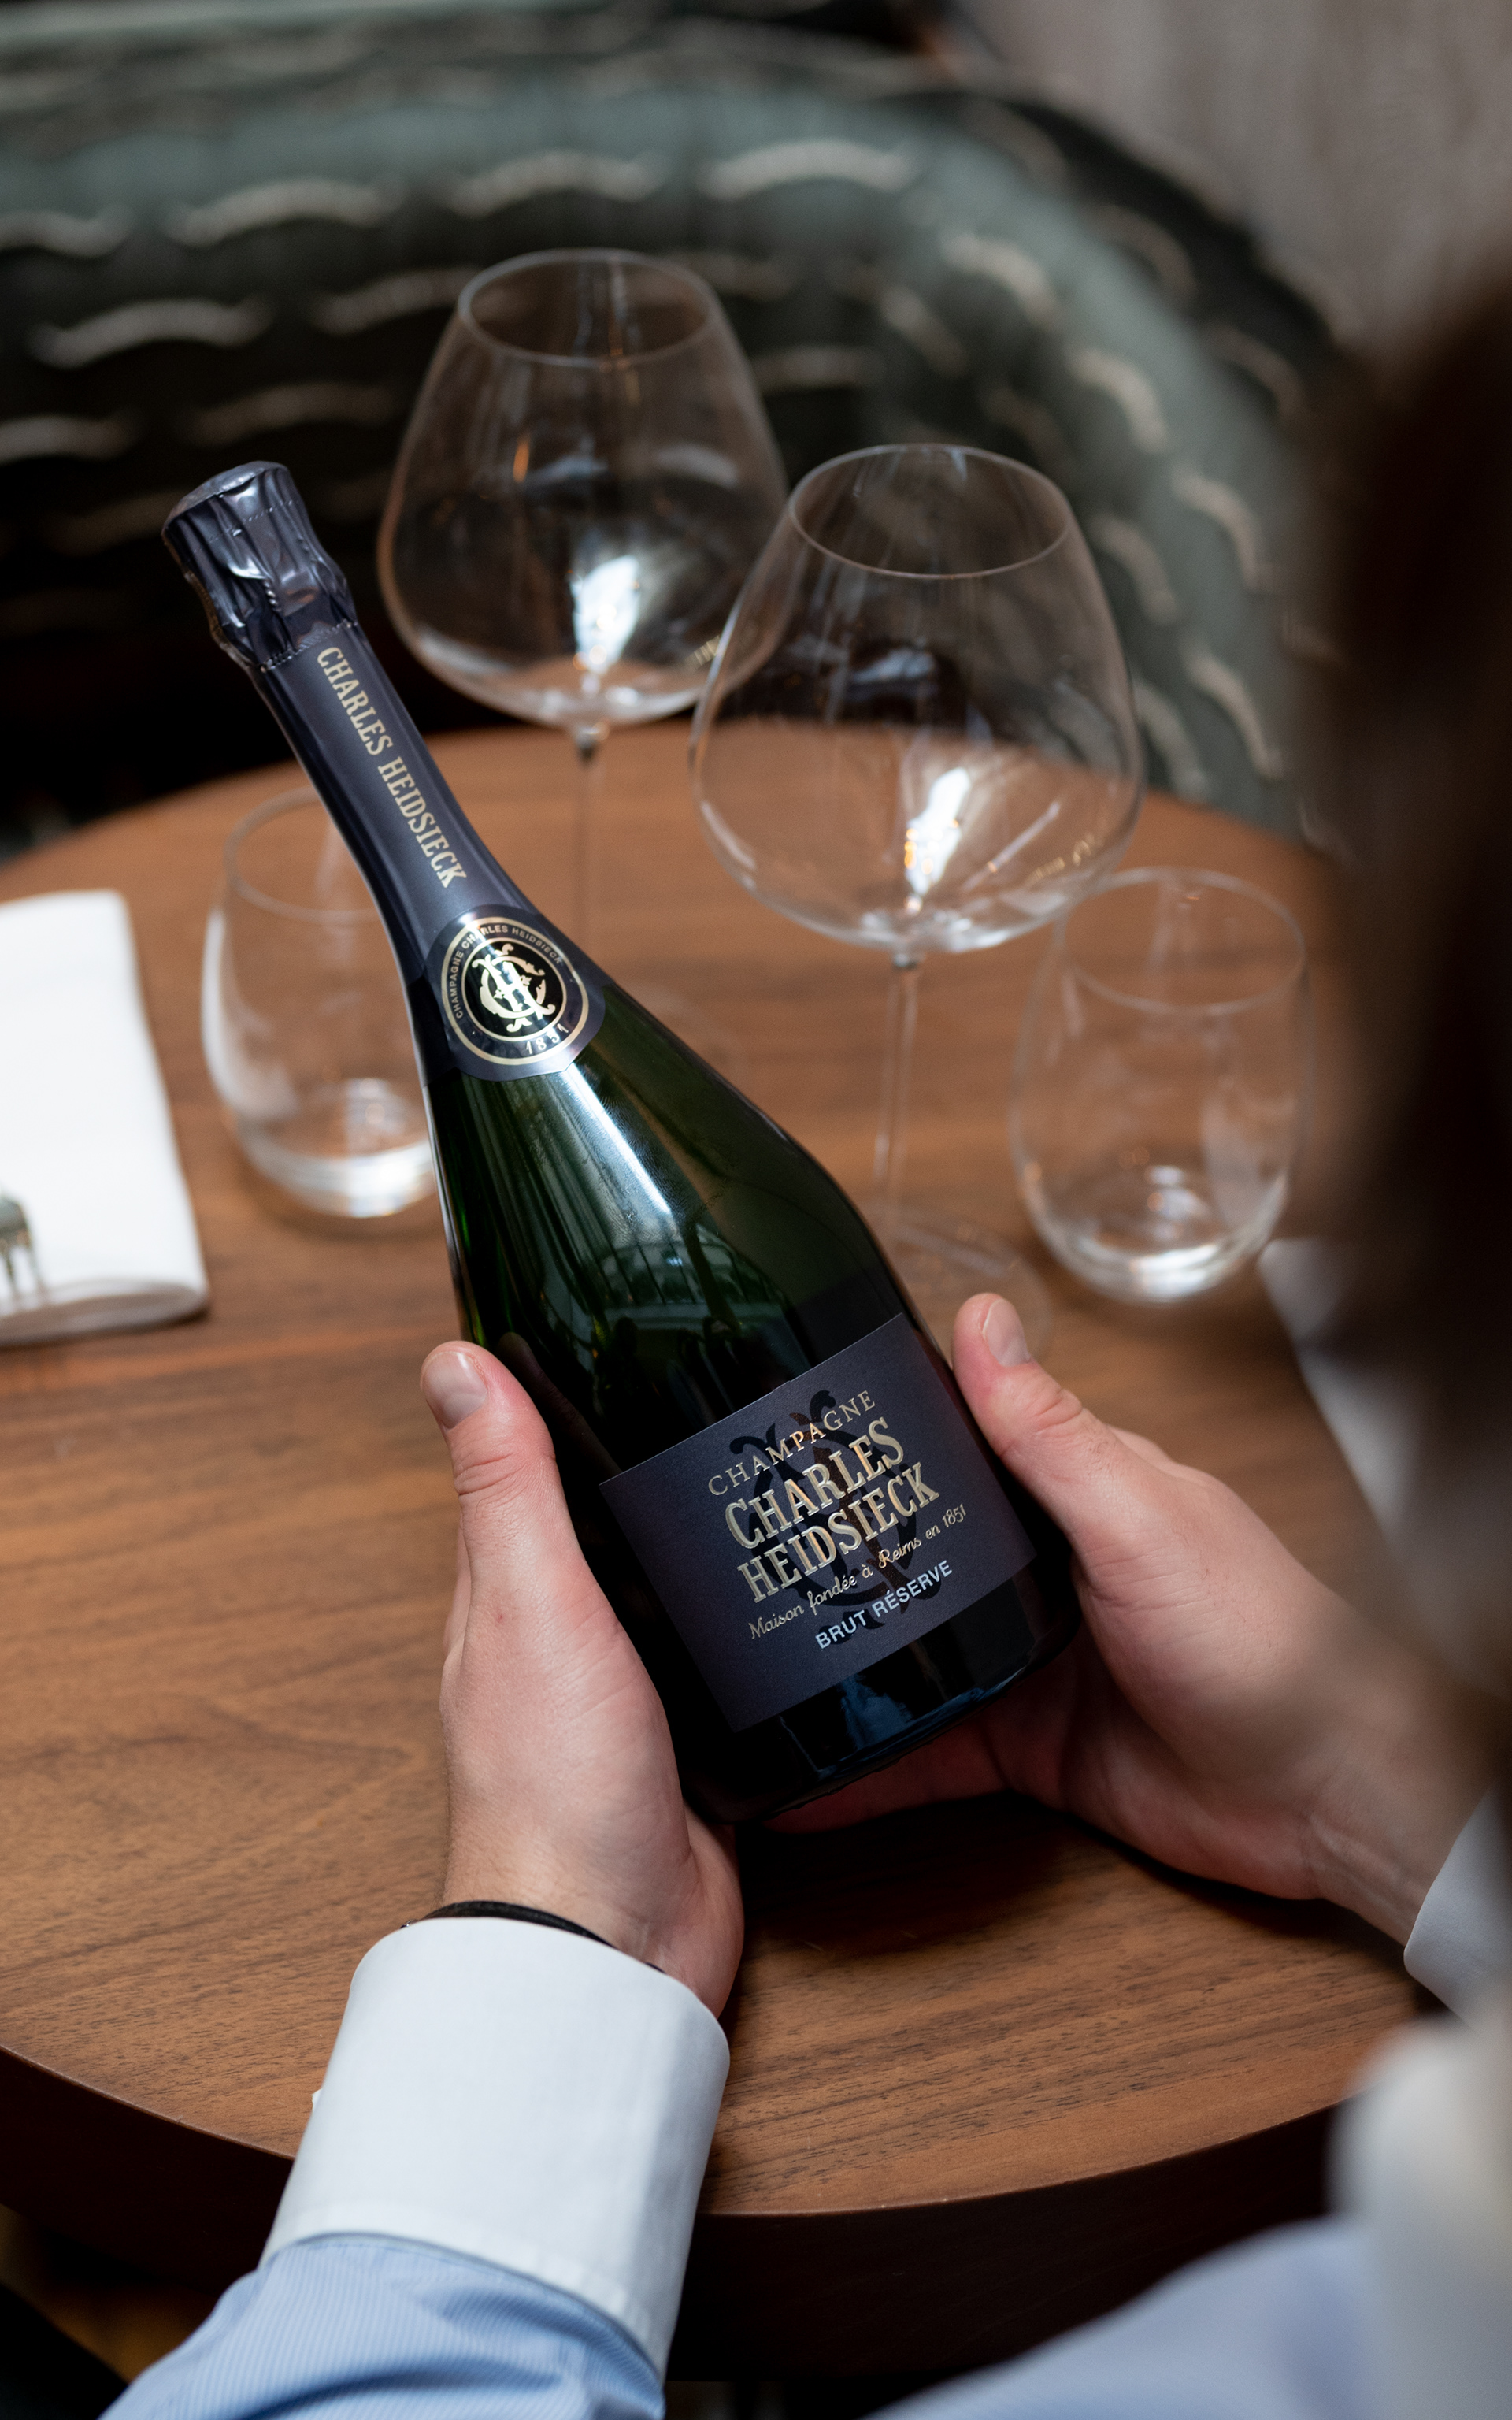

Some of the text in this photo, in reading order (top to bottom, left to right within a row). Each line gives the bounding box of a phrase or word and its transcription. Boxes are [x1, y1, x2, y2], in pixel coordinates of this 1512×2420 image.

[317, 646, 467, 888] CHARLES HEIDSIECK
[447, 924, 564, 1019] CHAMPAGNE CHRLES HEIDSIECK
[525, 1023, 569, 1055] 1851
[708, 1390, 876, 1496] CHAMPAGNE
[724, 1416, 906, 1550] CHARLES
[737, 1461, 940, 1604] HEIDSIECK
[747, 1503, 966, 1640] Maison fondée à Reims en 1851
[814, 1560, 953, 1650] BRUT RÉSERVE
